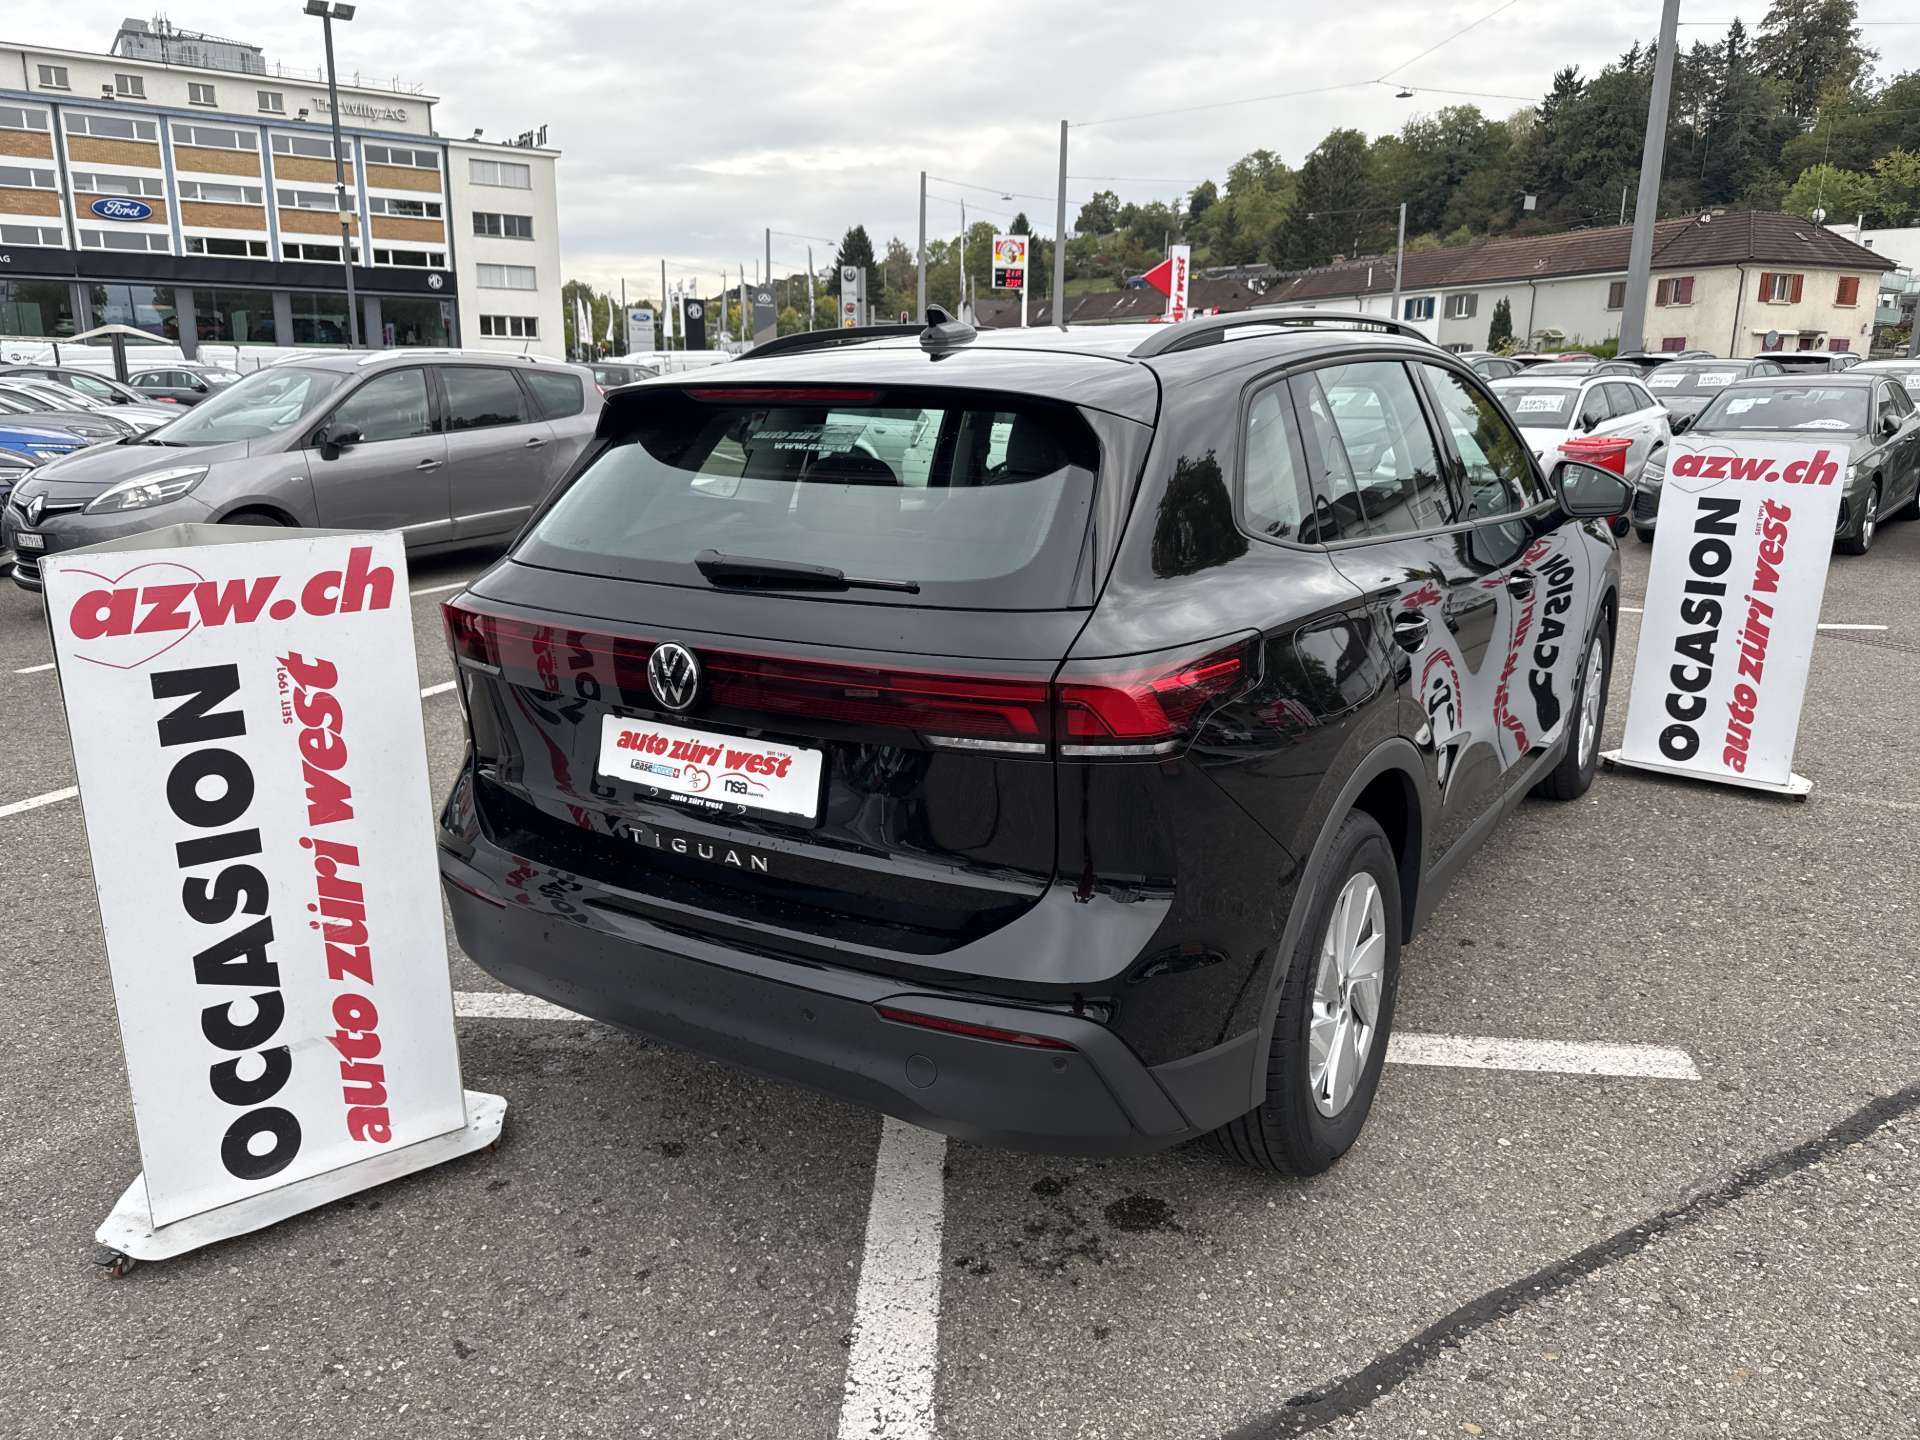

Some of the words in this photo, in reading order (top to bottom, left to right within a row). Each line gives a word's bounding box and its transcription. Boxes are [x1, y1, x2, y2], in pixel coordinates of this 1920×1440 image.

[342, 101, 378, 120] Willy
[384, 105, 407, 121] AG
[104, 200, 140, 216] Ford
[1671, 449, 1840, 487] azw.ch
[1752, 498, 1793, 594] west
[1754, 522, 1762, 536] SEIT
[69, 545, 395, 640] azw.ch
[1658, 497, 1742, 762] OCCASION
[1735, 594, 1775, 686] züri
[276, 666, 290, 696] 1991
[282, 699, 294, 725] SEIT
[1722, 682, 1758, 774] auto
[275, 650, 354, 827] west
[616, 730, 669, 757] auto
[667, 738, 725, 767] züri
[724, 748, 793, 779] west
[670, 792, 687, 803] auto
[687, 795, 705, 806] züri
[705, 800, 724, 811] west
[724, 779, 748, 795] nsa
[628, 827, 769, 873] TIGUAN
[149, 662, 302, 1181] OCCASION
[298, 836, 374, 986] züri
[325, 993, 393, 1144] auto
